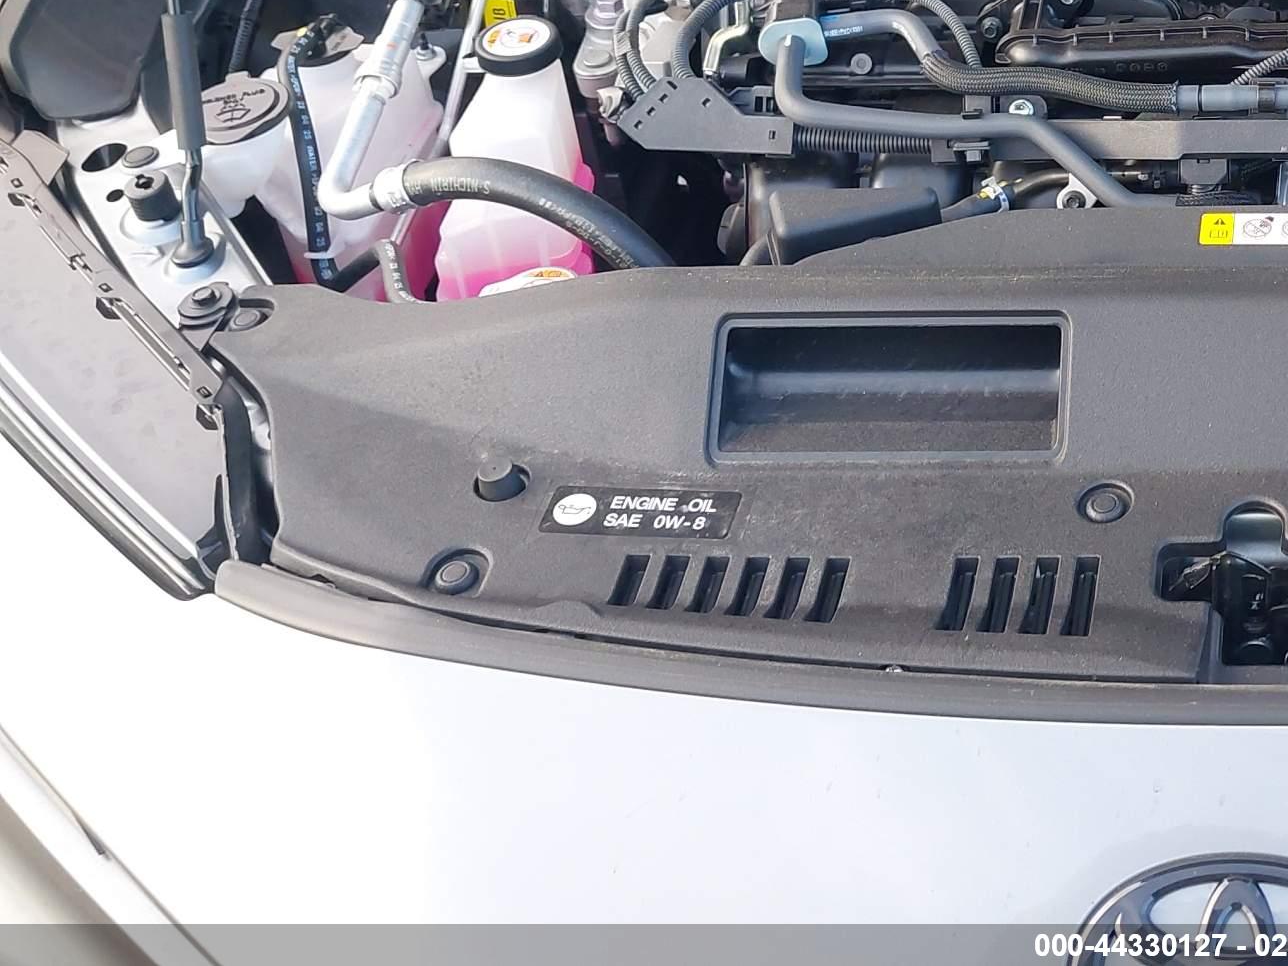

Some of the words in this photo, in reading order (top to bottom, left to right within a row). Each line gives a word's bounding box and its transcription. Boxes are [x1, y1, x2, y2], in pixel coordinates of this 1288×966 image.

[610, 495, 678, 512] ENGINE
[687, 498, 717, 513] OIL
[603, 513, 643, 528] SAE
[653, 516, 706, 530] 0W-8
